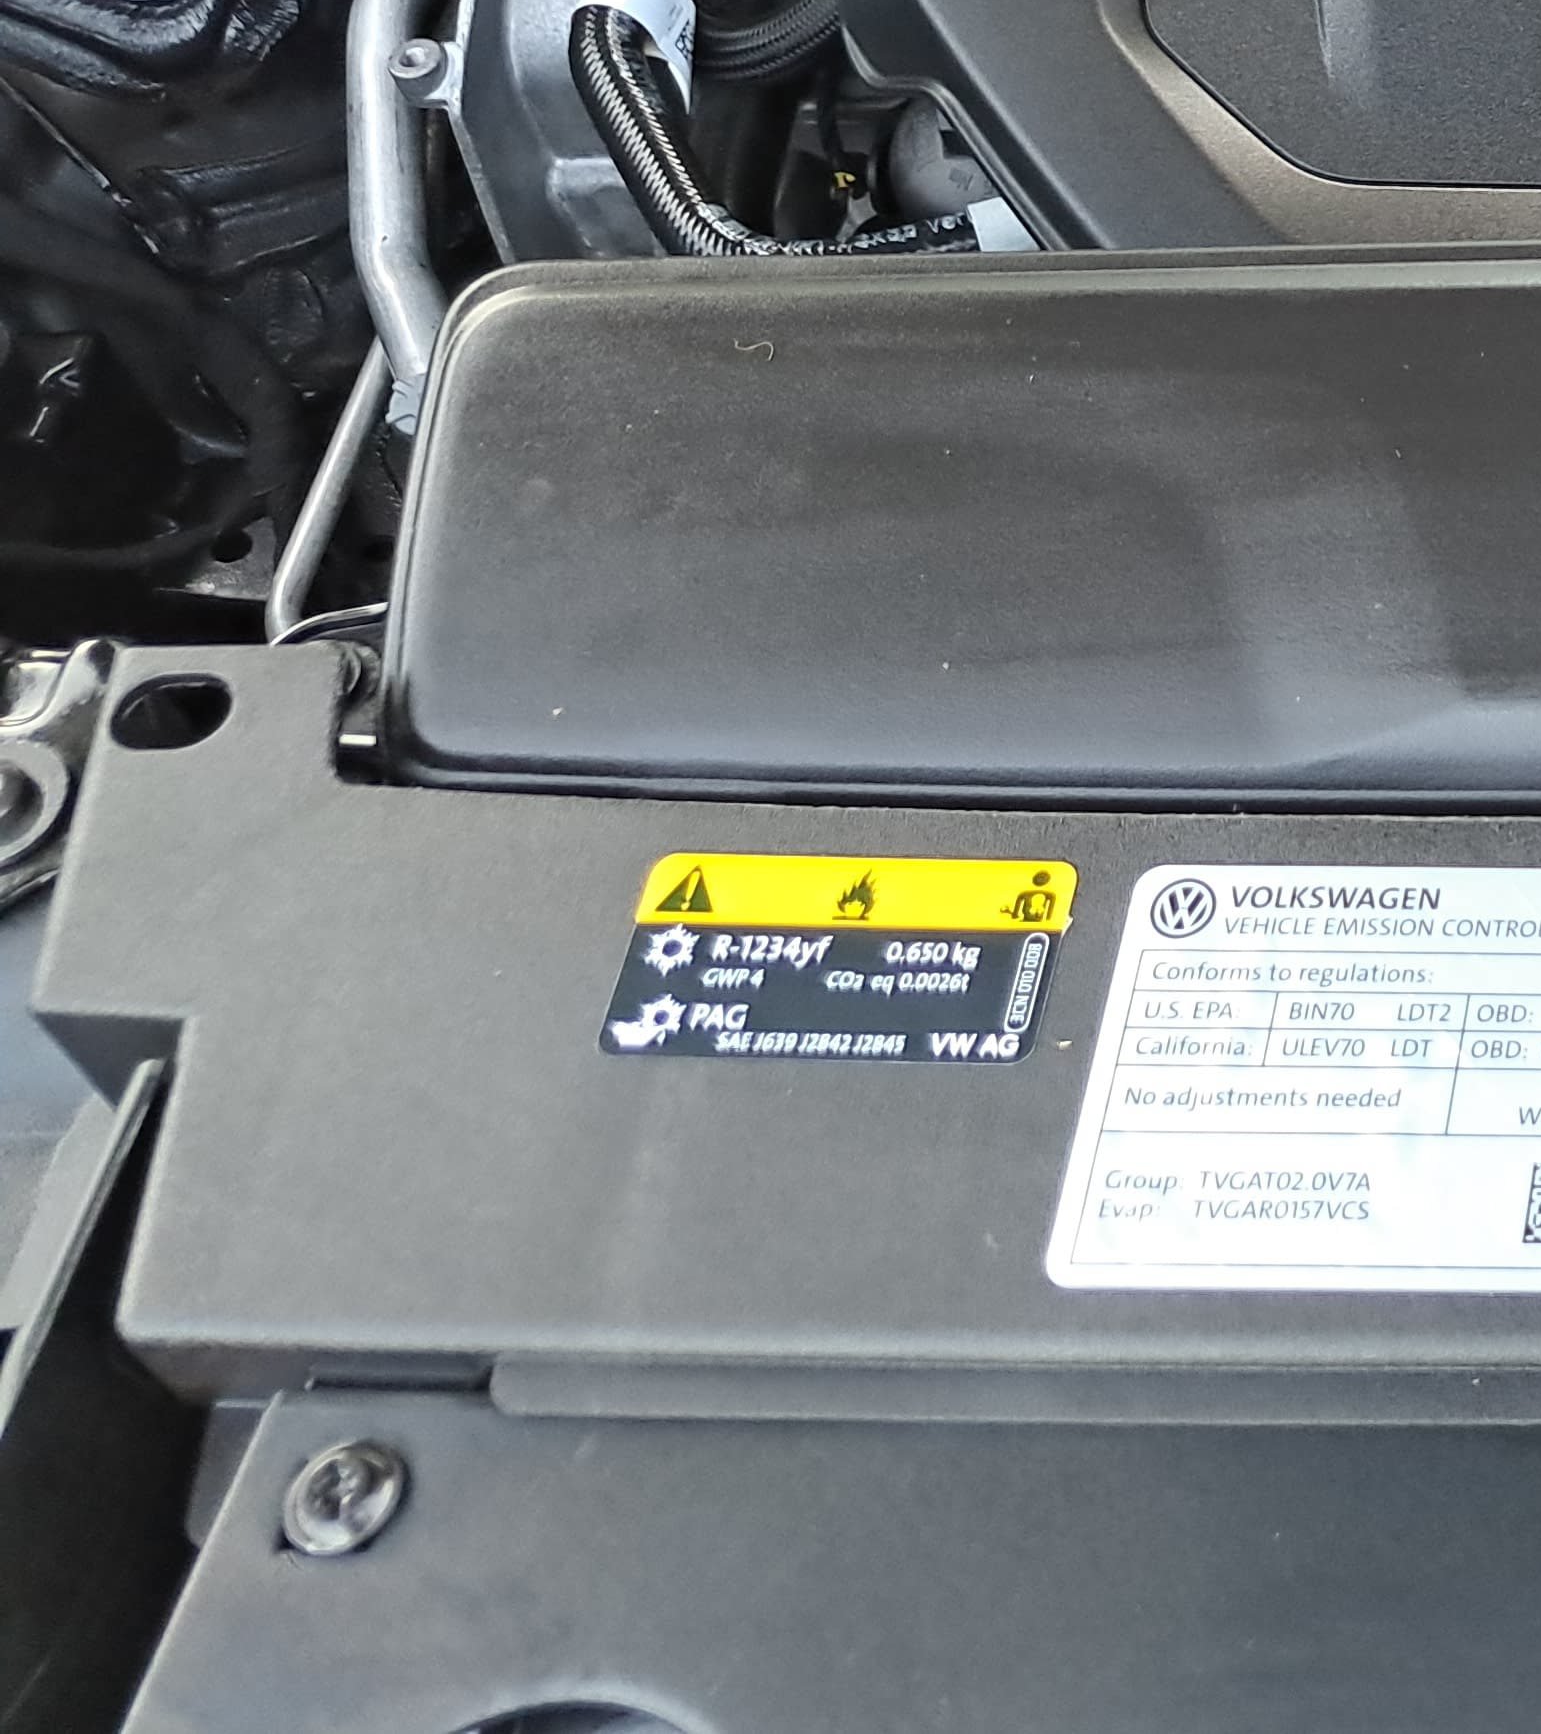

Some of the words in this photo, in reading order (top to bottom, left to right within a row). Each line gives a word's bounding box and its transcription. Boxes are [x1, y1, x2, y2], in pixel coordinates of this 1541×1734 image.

[1232, 885, 1441, 910] VOLKSWAGEN
[1225, 917, 1315, 935] VEHICLE
[1323, 917, 1435, 936] EMISSION
[711, 934, 834, 969] R-1234yf
[884, 941, 949, 964] 0.650
[951, 941, 981, 971] kg
[700, 967, 750, 988] GWP
[749, 968, 765, 988] 4
[1152, 961, 1261, 981] Conforms
[1269, 964, 1292, 982] to
[1299, 963, 1432, 988] regulations:
[870, 975, 895, 996] eq
[689, 1003, 749, 1031] PAG
[1289, 1001, 1355, 1021] BIN70
[1397, 1003, 1451, 1022] LDT2
[1477, 1004, 1534, 1023] OBD:
[715, 1031, 754, 1052] SAE
[797, 1033, 853, 1054] J2842
[852, 1034, 907, 1054] J2845
[931, 1032, 978, 1057] VW
[978, 1033, 1020, 1059] AG
[1282, 1037, 1366, 1057] ULEV70
[1390, 1038, 1433, 1058] LDT
[1470, 1039, 1527, 1059] OBD:
[1124, 1087, 1157, 1105] No
[1162, 1086, 1308, 1112] adjustments
[1316, 1088, 1402, 1108] needed
